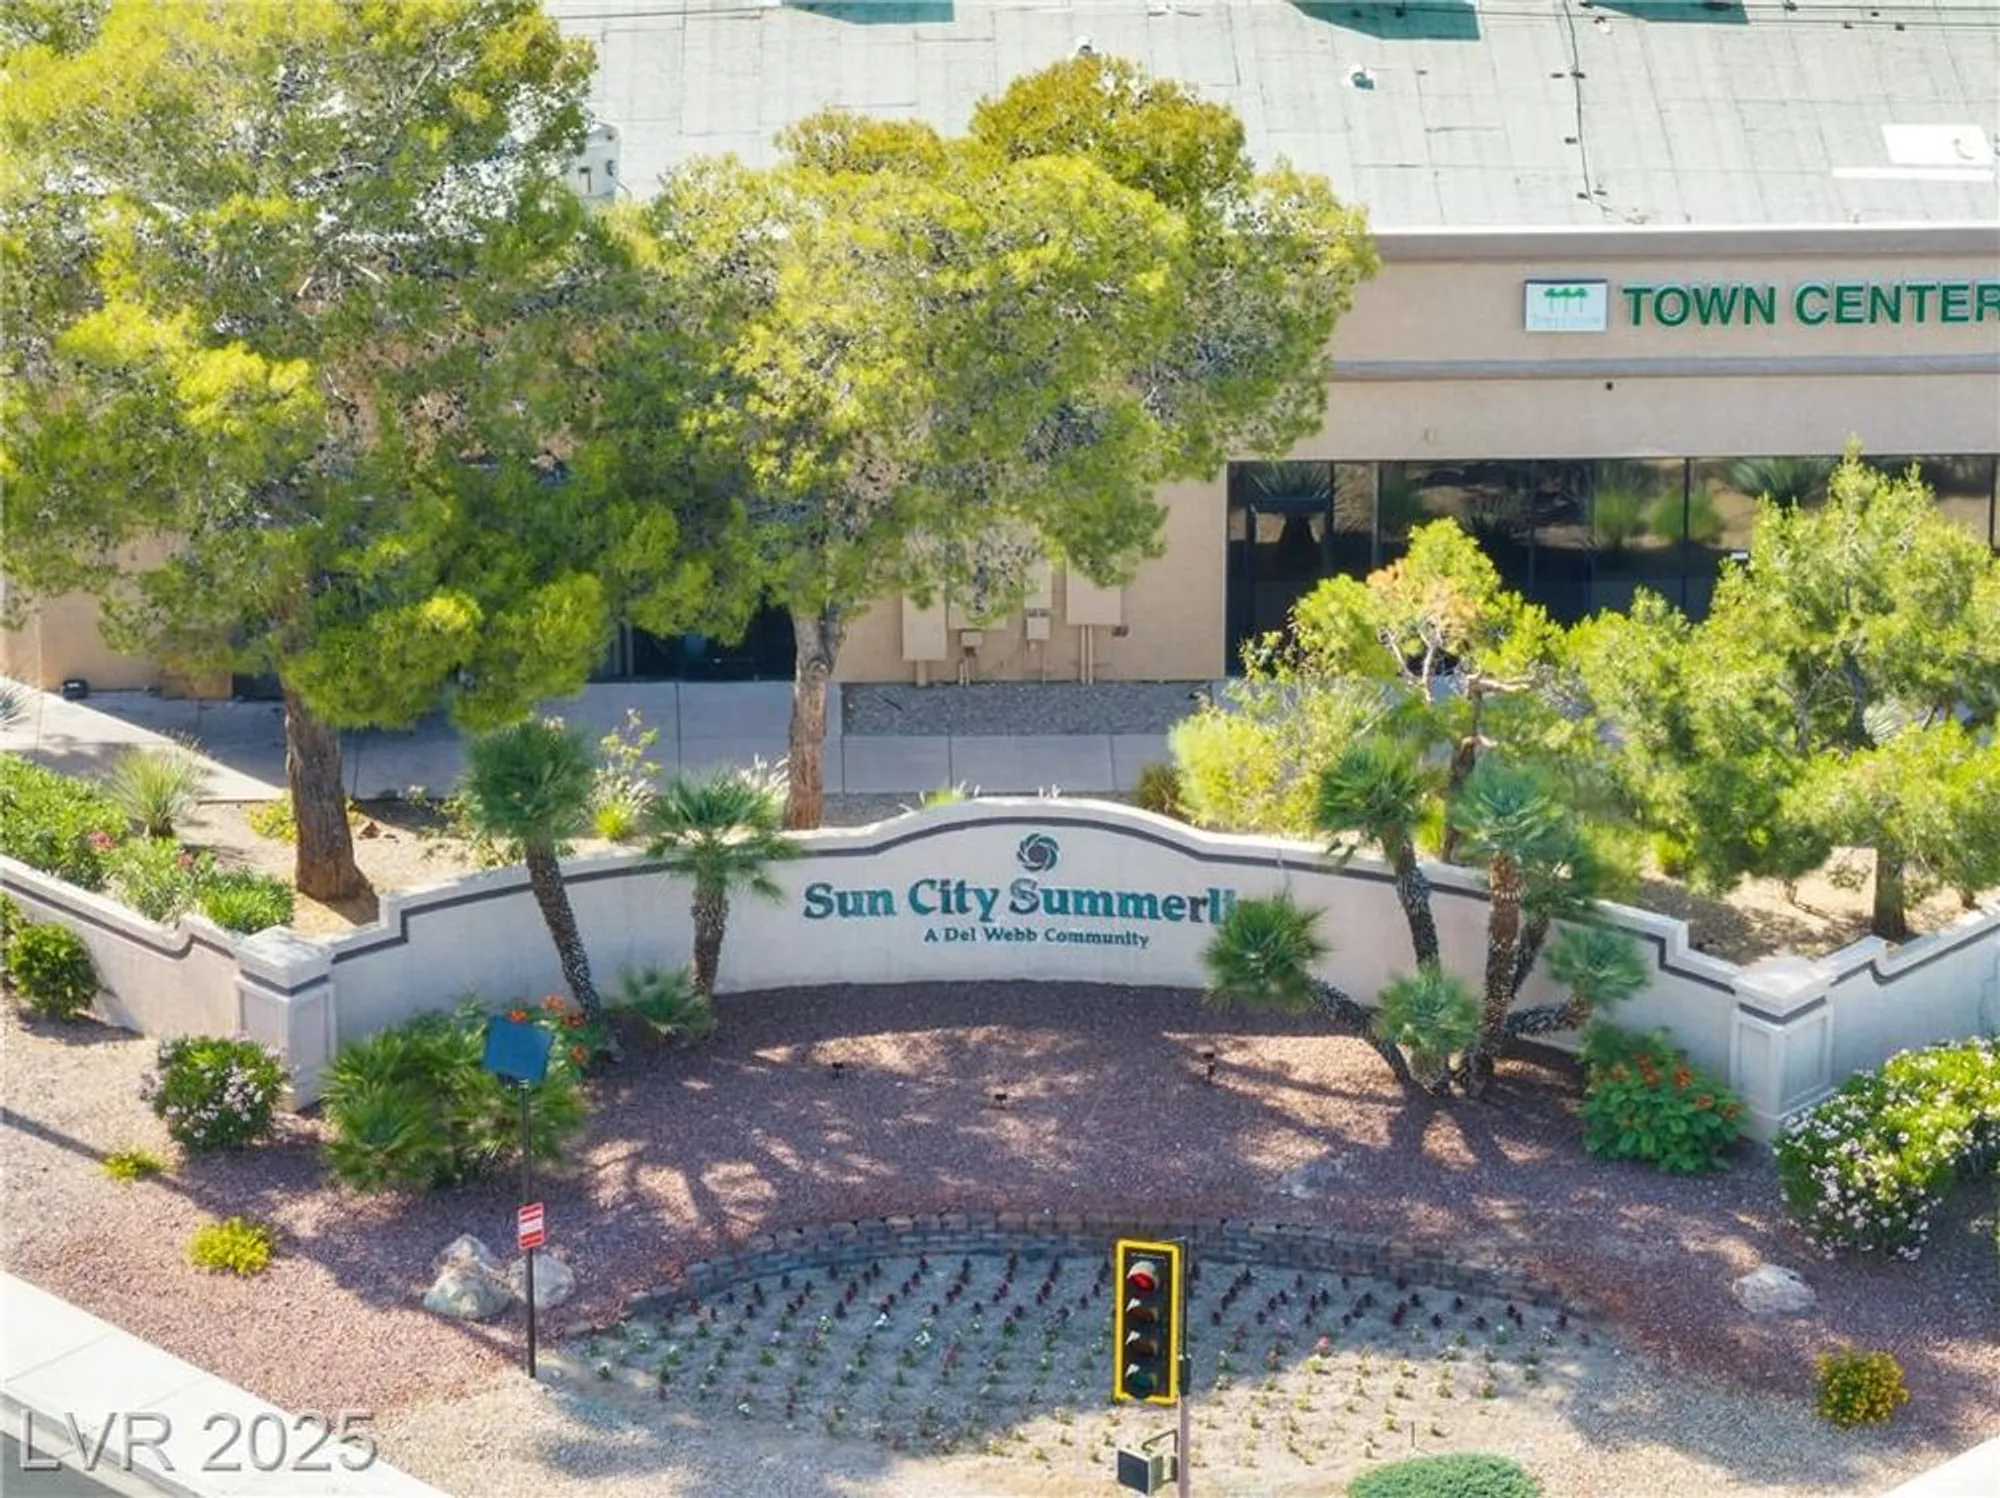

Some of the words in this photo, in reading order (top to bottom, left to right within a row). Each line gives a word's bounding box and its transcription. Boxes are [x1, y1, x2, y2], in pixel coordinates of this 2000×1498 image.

[1623, 284, 1776, 325] TOWN
[1795, 284, 2000, 325] CENTER
[803, 882, 895, 919] Sun
[908, 878, 1000, 922] City
[924, 928, 938, 942] A
[944, 928, 976, 942] Del
[985, 928, 1038, 942] Webb
[1046, 929, 1150, 949] Community
